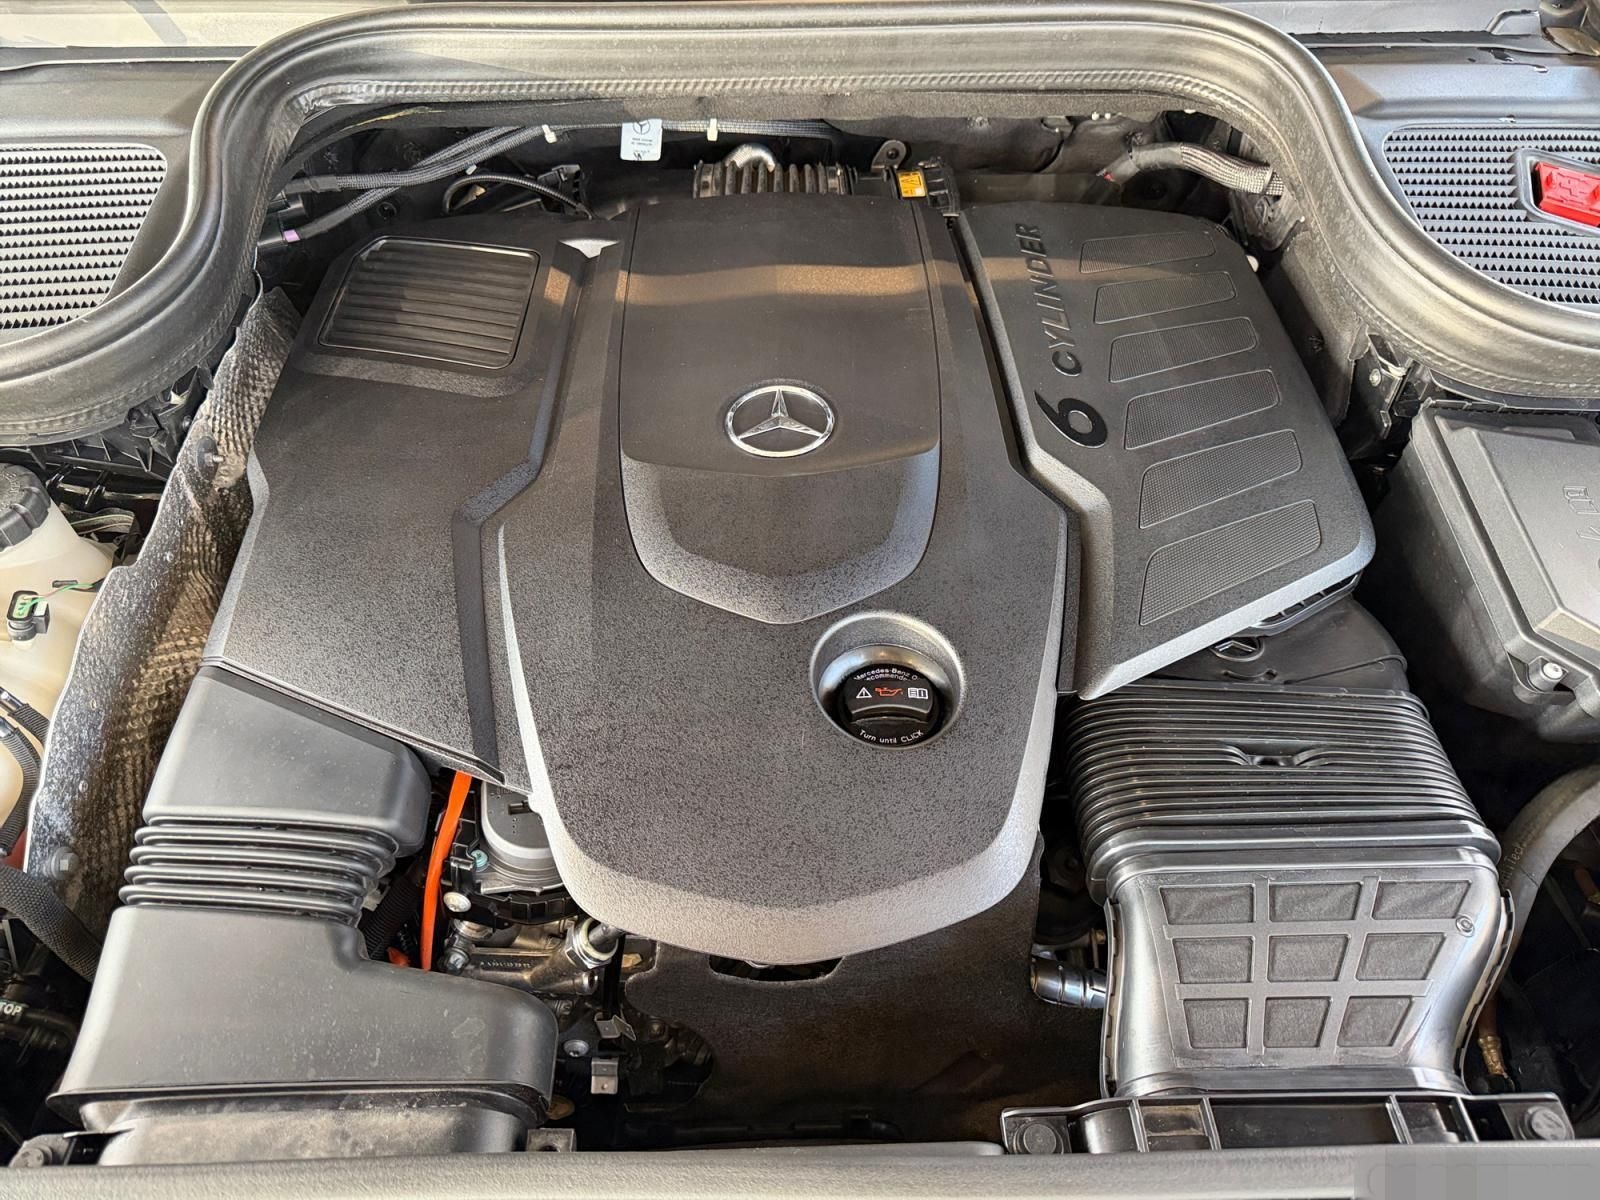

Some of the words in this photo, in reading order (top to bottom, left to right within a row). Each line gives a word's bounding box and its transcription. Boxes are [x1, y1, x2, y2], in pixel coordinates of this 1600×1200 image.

[1015, 223, 1082, 377] CYLINDER
[1034, 390, 1108, 448] 6
[860, 729, 877, 741] Turn
[880, 736, 897, 744] until
[900, 729, 924, 742] CLICK
